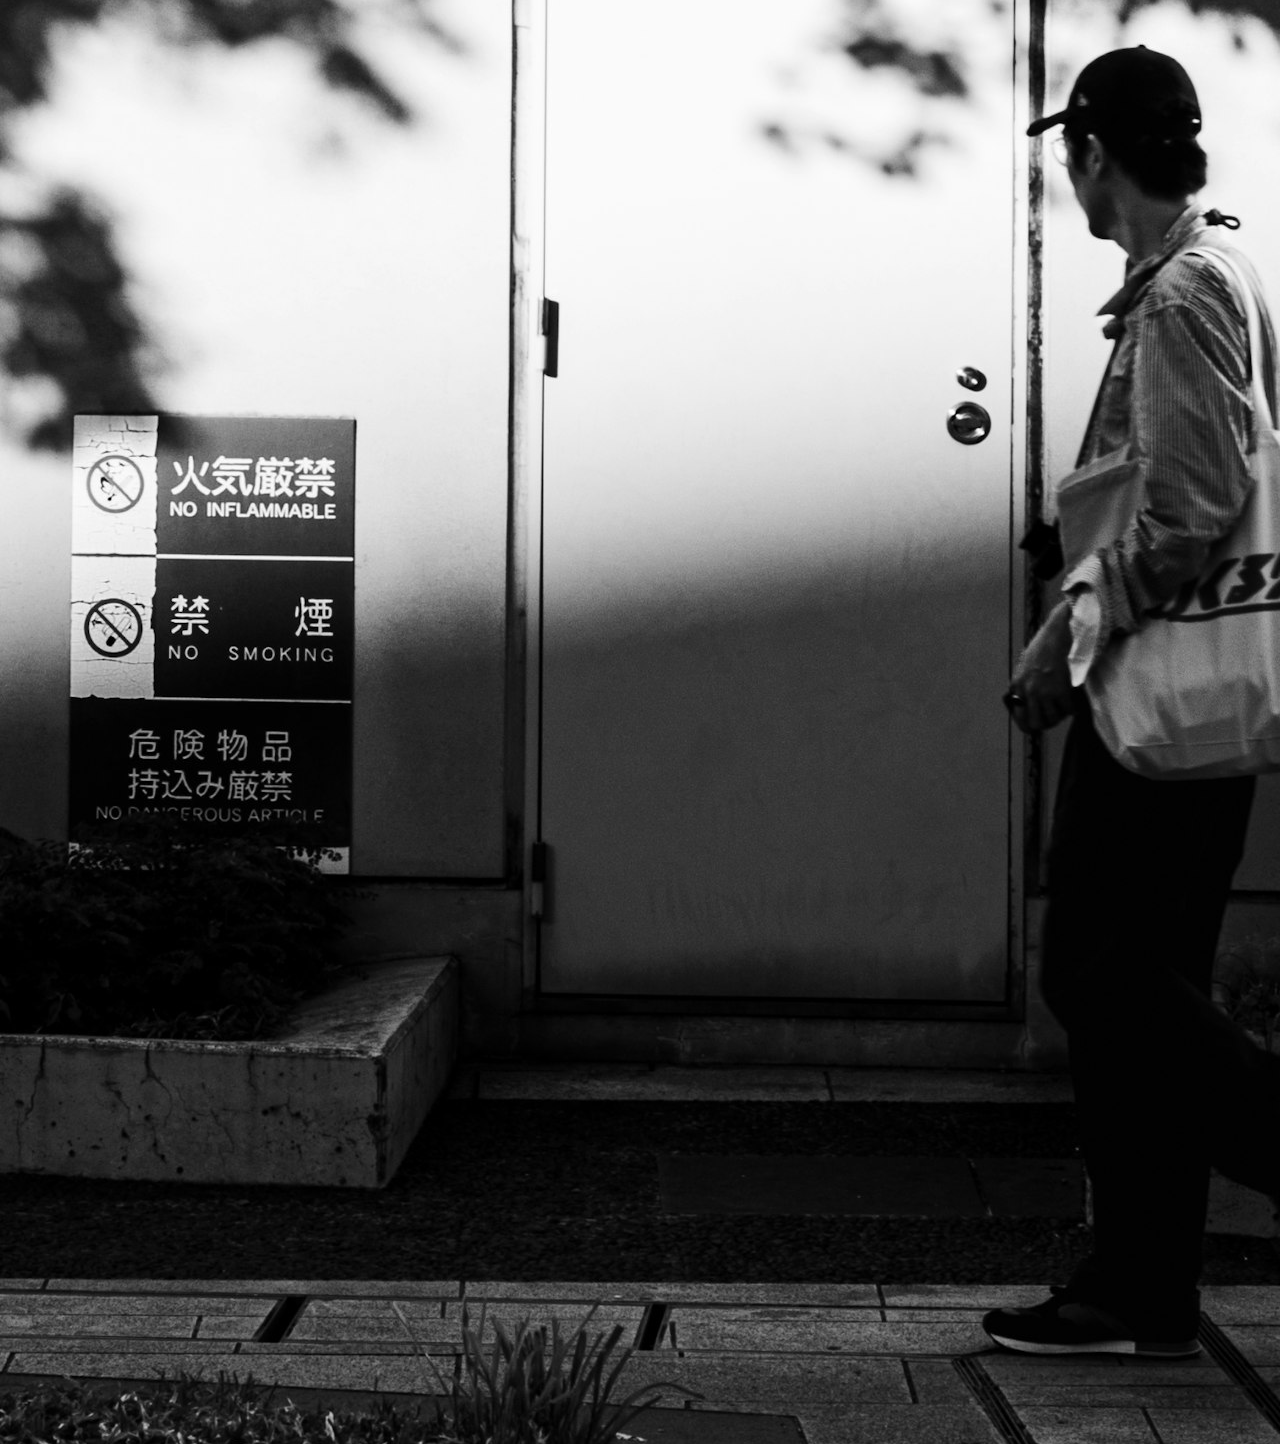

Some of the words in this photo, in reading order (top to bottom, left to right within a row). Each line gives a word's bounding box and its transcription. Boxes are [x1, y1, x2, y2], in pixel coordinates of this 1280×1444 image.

[170, 455, 335, 498] 火気厳禁
[170, 501, 198, 517] NO
[207, 502, 337, 520] INFLAMMABLE
[168, 645, 199, 661] NO
[228, 646, 334, 663] SMOKING
[128, 728, 292, 762] 危険物品
[128, 768, 293, 802] 持込み厳禁
[96, 805, 122, 820] NO
